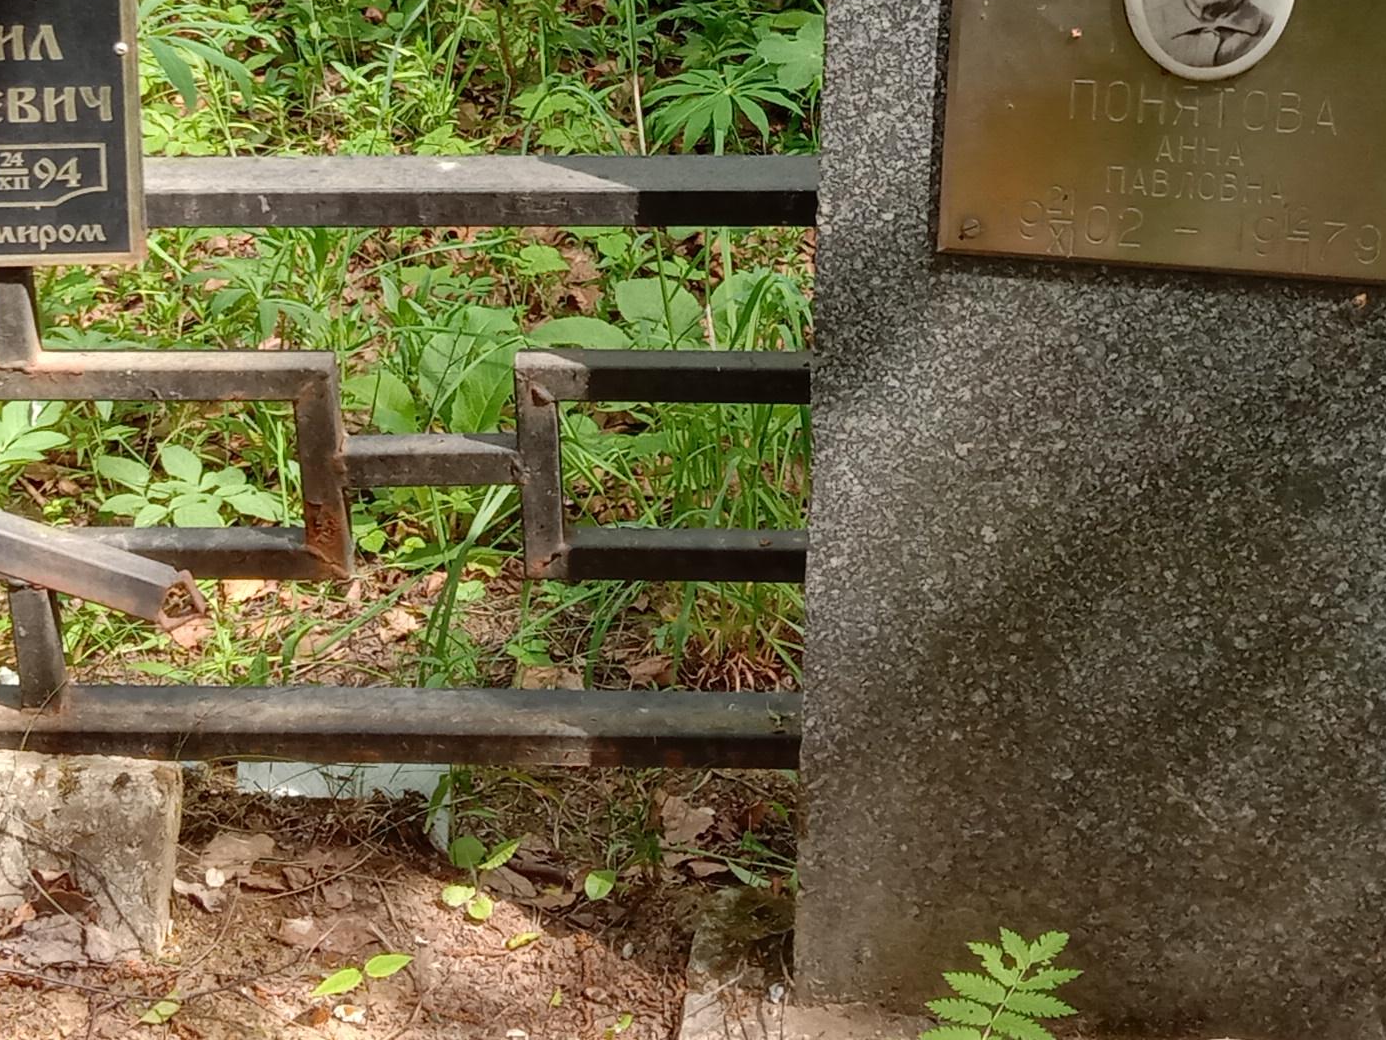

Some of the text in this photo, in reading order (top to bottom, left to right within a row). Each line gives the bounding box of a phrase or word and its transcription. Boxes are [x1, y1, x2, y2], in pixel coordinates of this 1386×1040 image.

[1069, 79, 1337, 136] ПОНЯТОВА
[1155, 135, 1245, 166] АННА
[1105, 165, 1286, 205] ПАВЛОВНА
[1085, 204, 1143, 248] 02
[1323, 220, 1382, 265] 79
